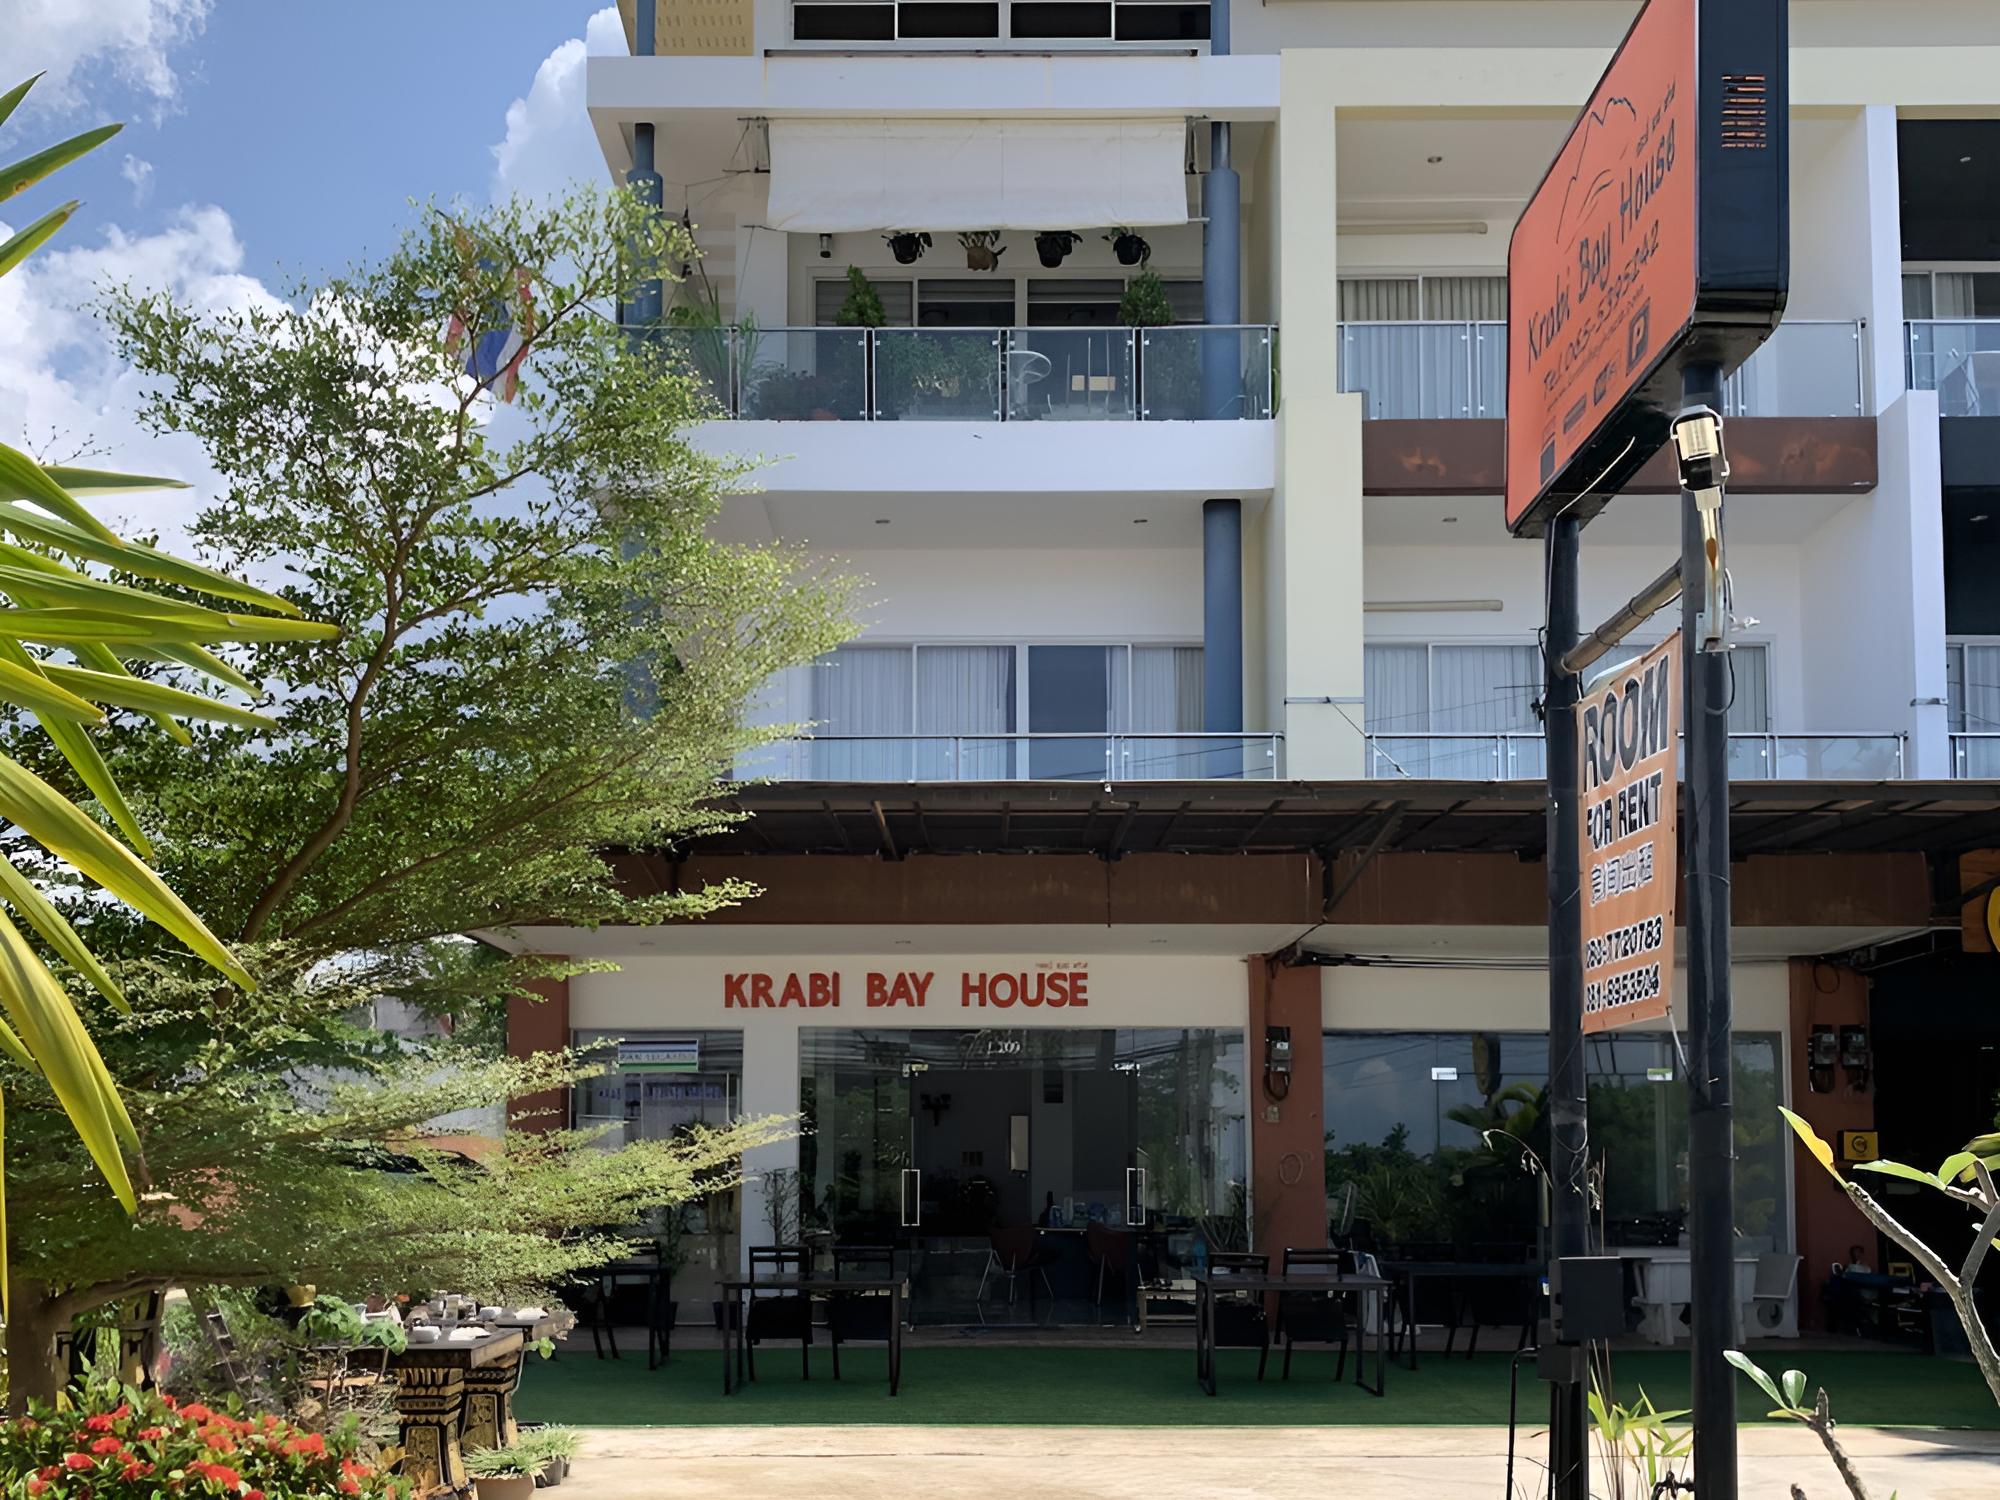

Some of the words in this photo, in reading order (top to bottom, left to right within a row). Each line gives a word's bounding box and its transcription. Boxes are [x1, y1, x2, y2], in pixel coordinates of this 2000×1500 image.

[1528, 266, 1571, 373] Krabi
[1577, 222, 1611, 304] Bay
[1619, 118, 1676, 243] House
[1584, 655, 1669, 792] ROOM
[1587, 797, 1614, 850] FOR
[1618, 772, 1663, 838] RENT
[724, 971, 840, 1009] KRABI
[866, 971, 935, 1009] BAY
[961, 971, 1089, 1009] HOUSE
